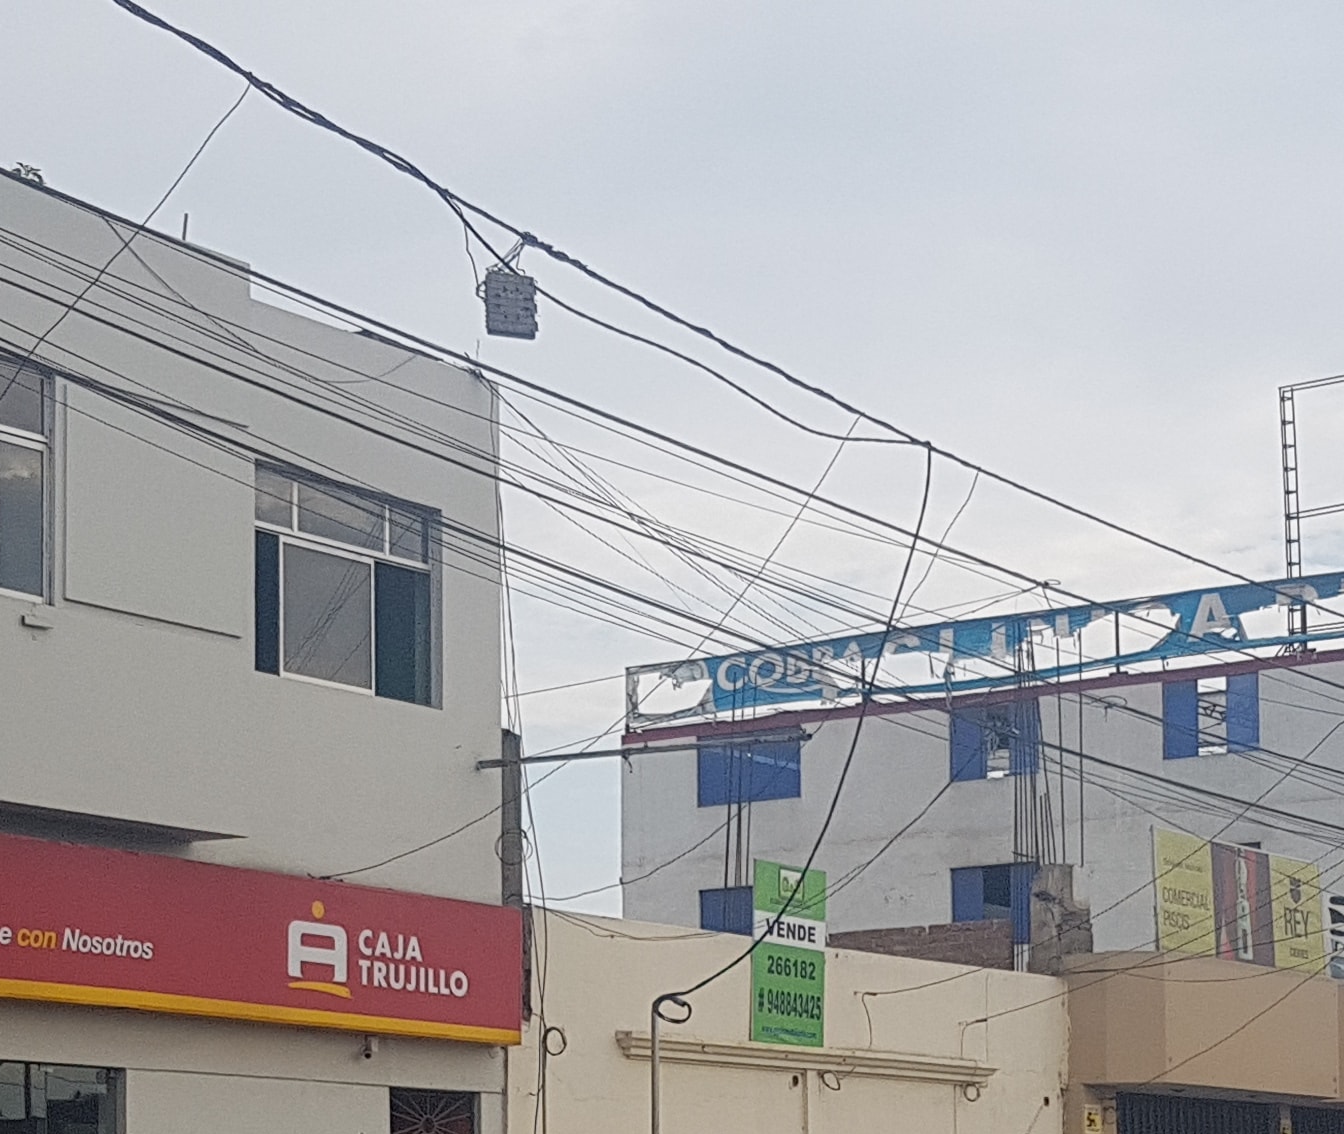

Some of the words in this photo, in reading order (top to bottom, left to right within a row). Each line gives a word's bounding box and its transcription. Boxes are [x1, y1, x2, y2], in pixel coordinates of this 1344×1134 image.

[767, 918, 817, 944] VENDE
[1283, 906, 1310, 940] REY
[17, 924, 56, 949] con
[61, 928, 154, 960] Nosotros
[358, 928, 423, 962] CAJA
[358, 959, 468, 997] TRUJILLO
[767, 955, 816, 980] 266182
[768, 988, 821, 1021] 948843425
